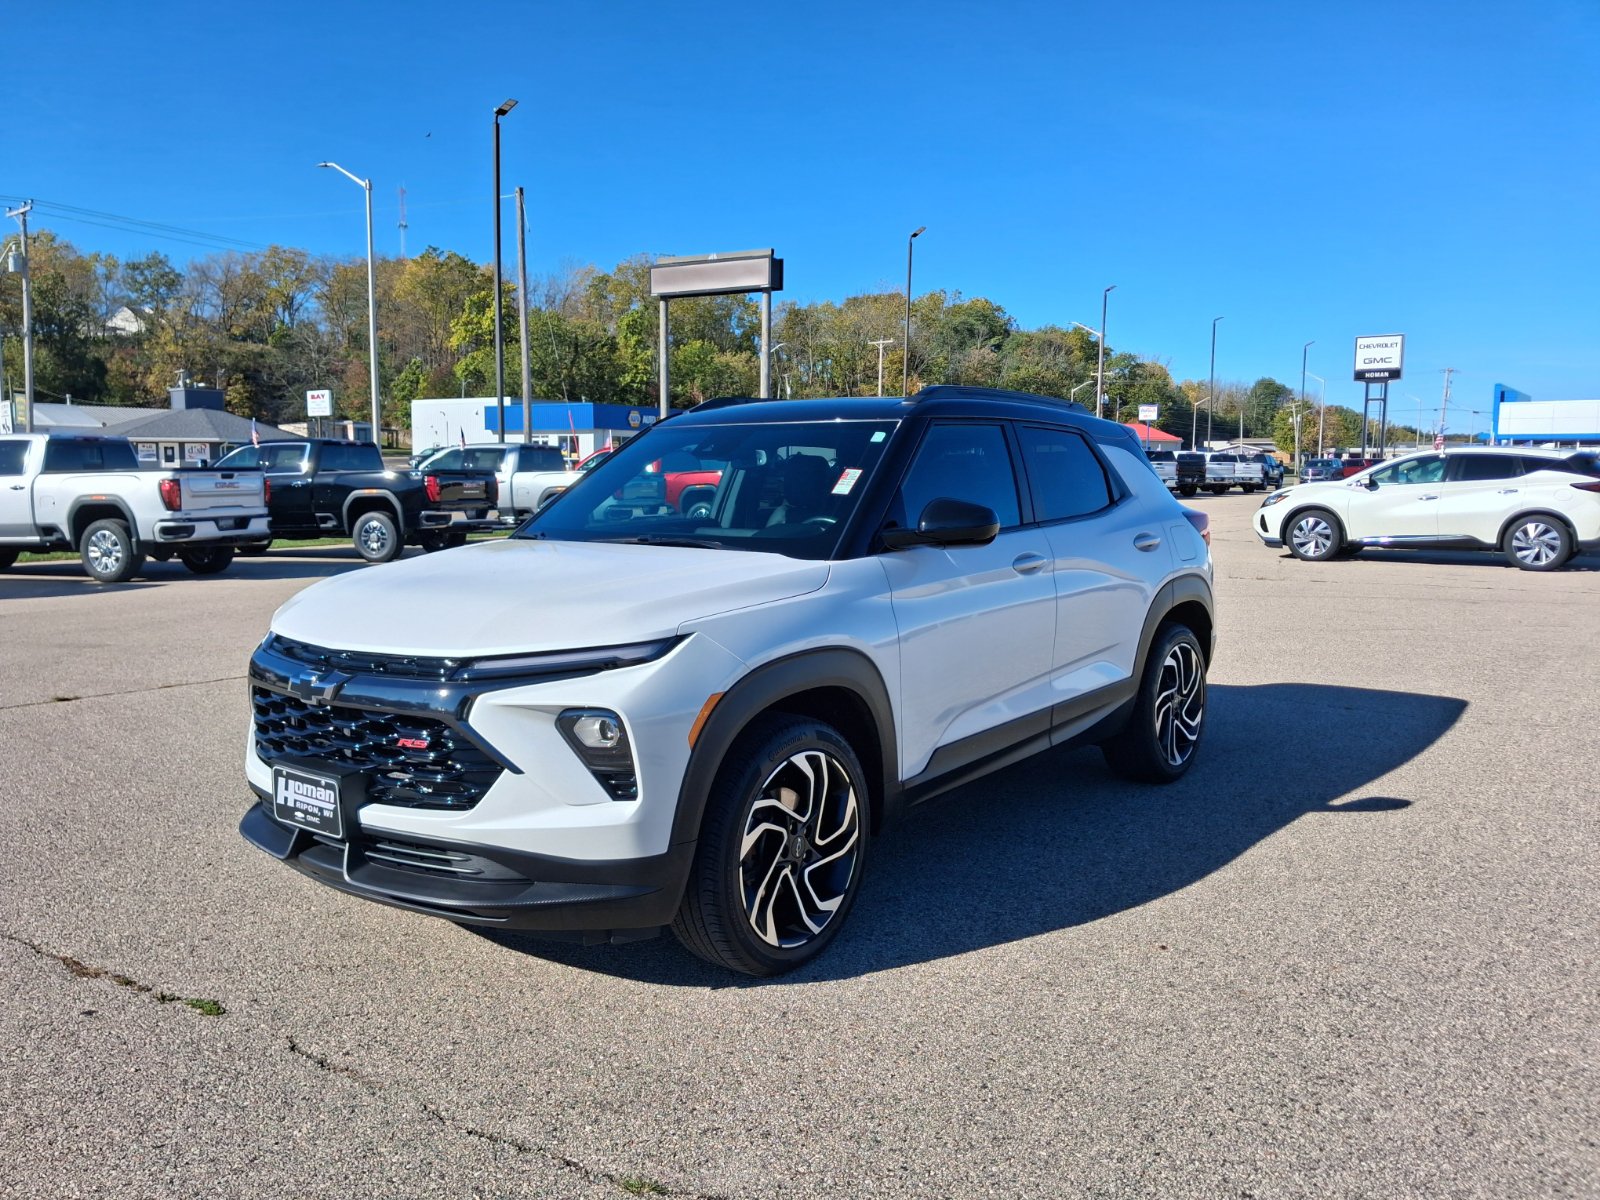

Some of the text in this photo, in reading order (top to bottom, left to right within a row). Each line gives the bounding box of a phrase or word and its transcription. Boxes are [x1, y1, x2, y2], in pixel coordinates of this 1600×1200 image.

[397, 738, 428, 749] RS
[277, 777, 335, 807] Homan
[296, 801, 334, 818] RIPON, WI
[306, 815, 321, 824] GMC
